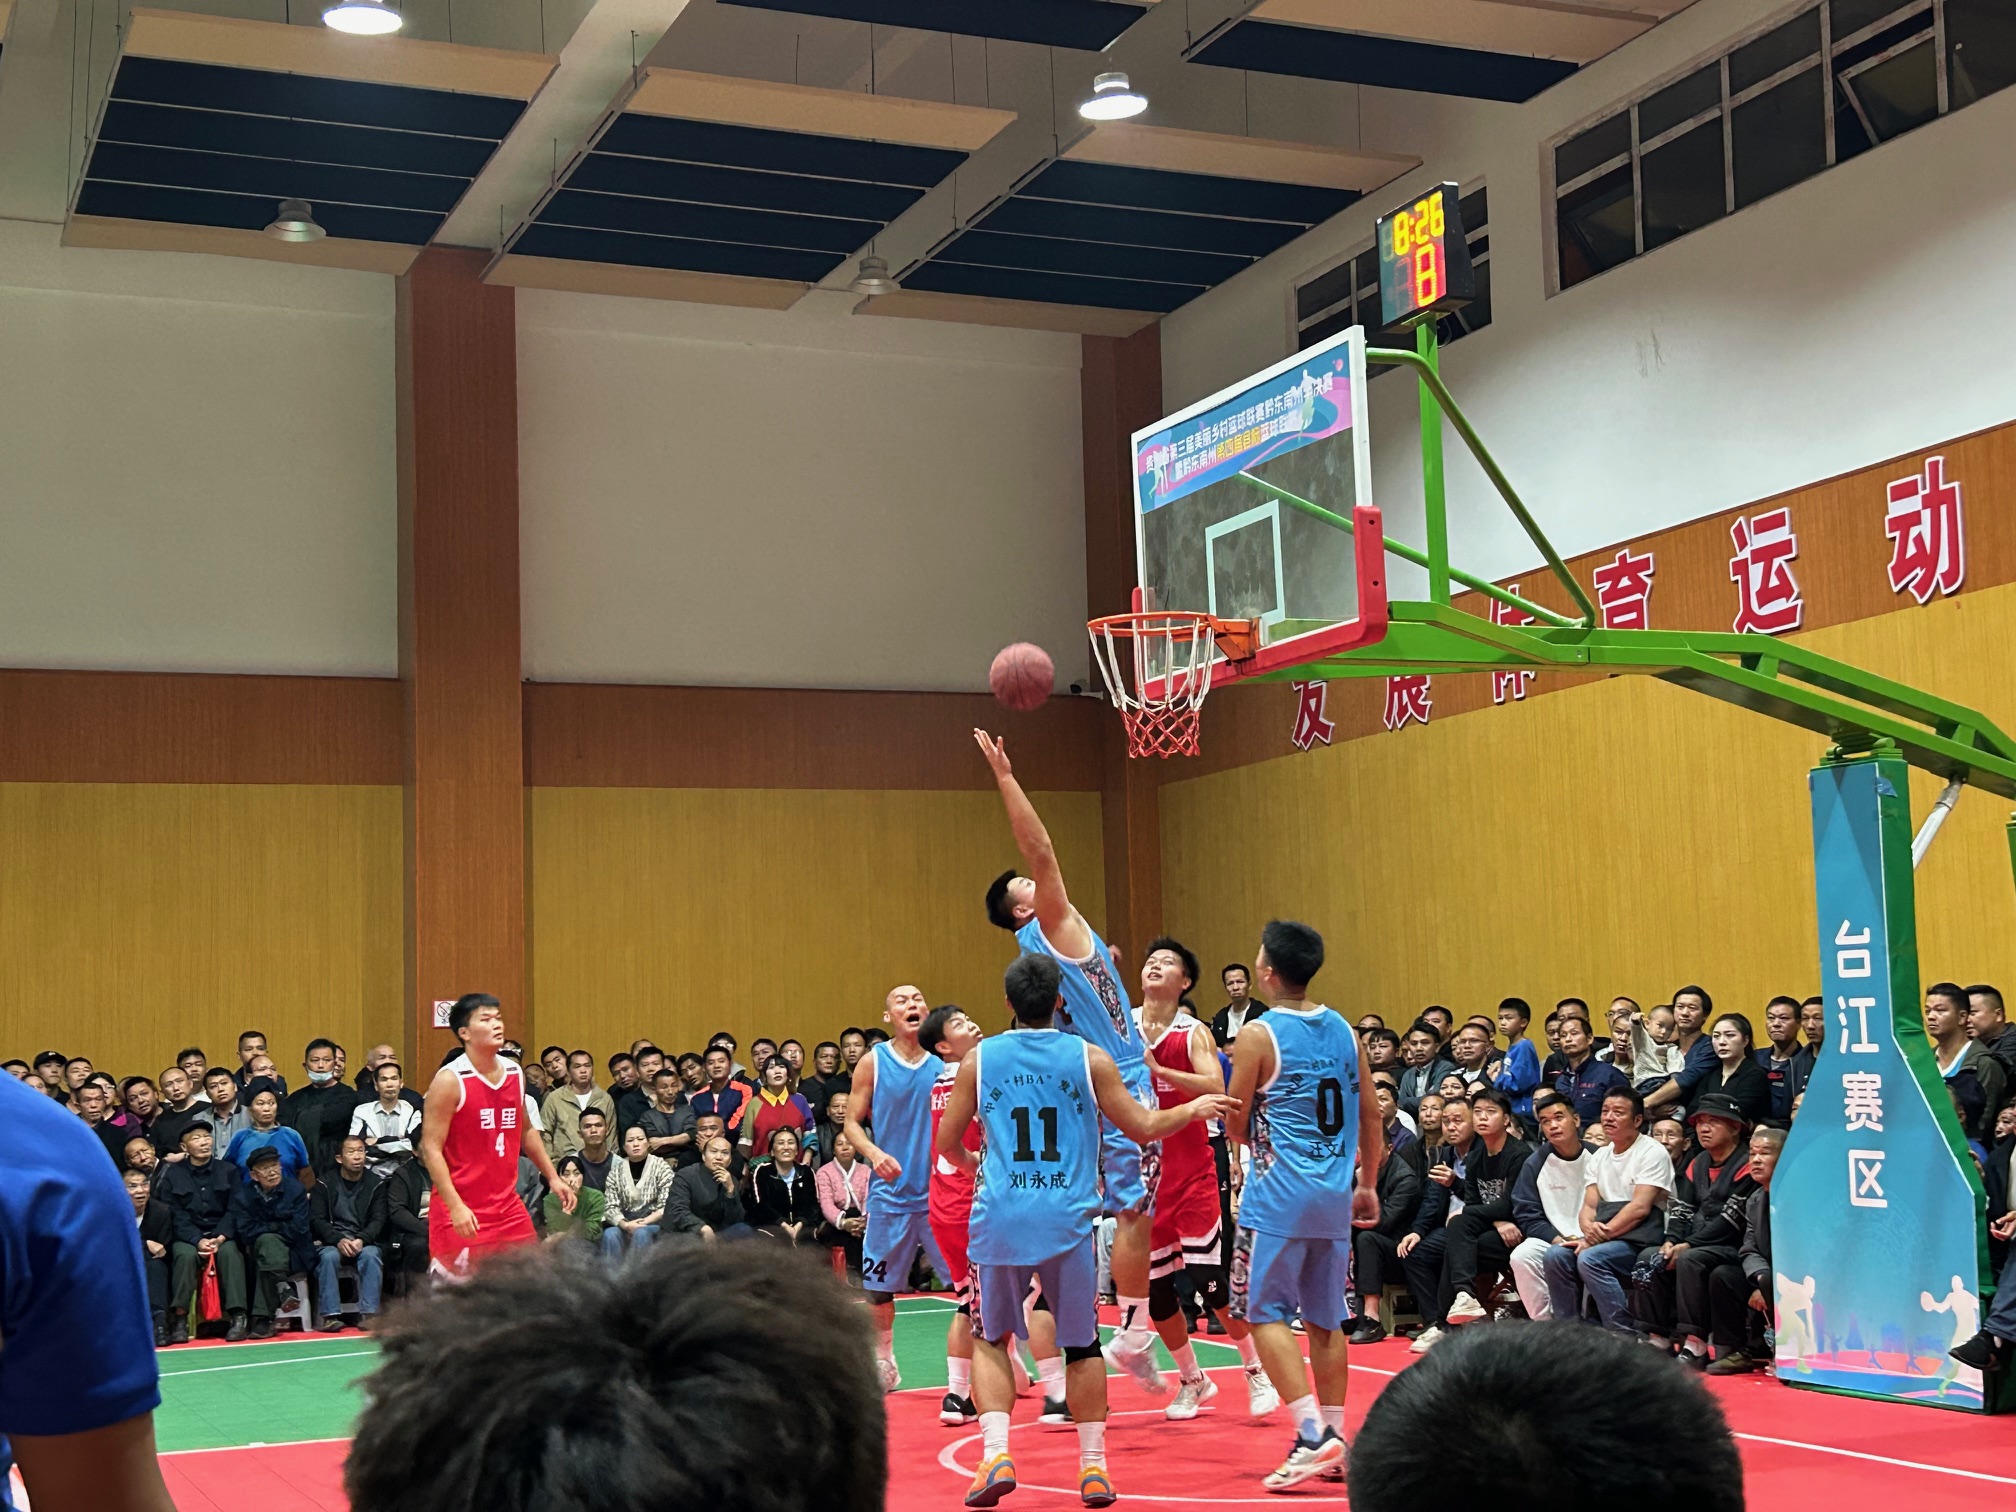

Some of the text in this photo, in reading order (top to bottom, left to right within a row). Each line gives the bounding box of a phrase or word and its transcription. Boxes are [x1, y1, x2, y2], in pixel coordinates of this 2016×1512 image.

[1393, 190, 1445, 256] 8:26
[1415, 242, 1437, 307] 8
[1835, 919, 1888, 1207] 台江赛区
[480, 1108, 517, 1129] 凯里
[1010, 1106, 1061, 1162] 11
[1316, 1077, 1345, 1137] 0
[494, 1132, 506, 1157] 4
[1008, 1170, 1068, 1190] 刘永成
[863, 1256, 888, 1283] 24
